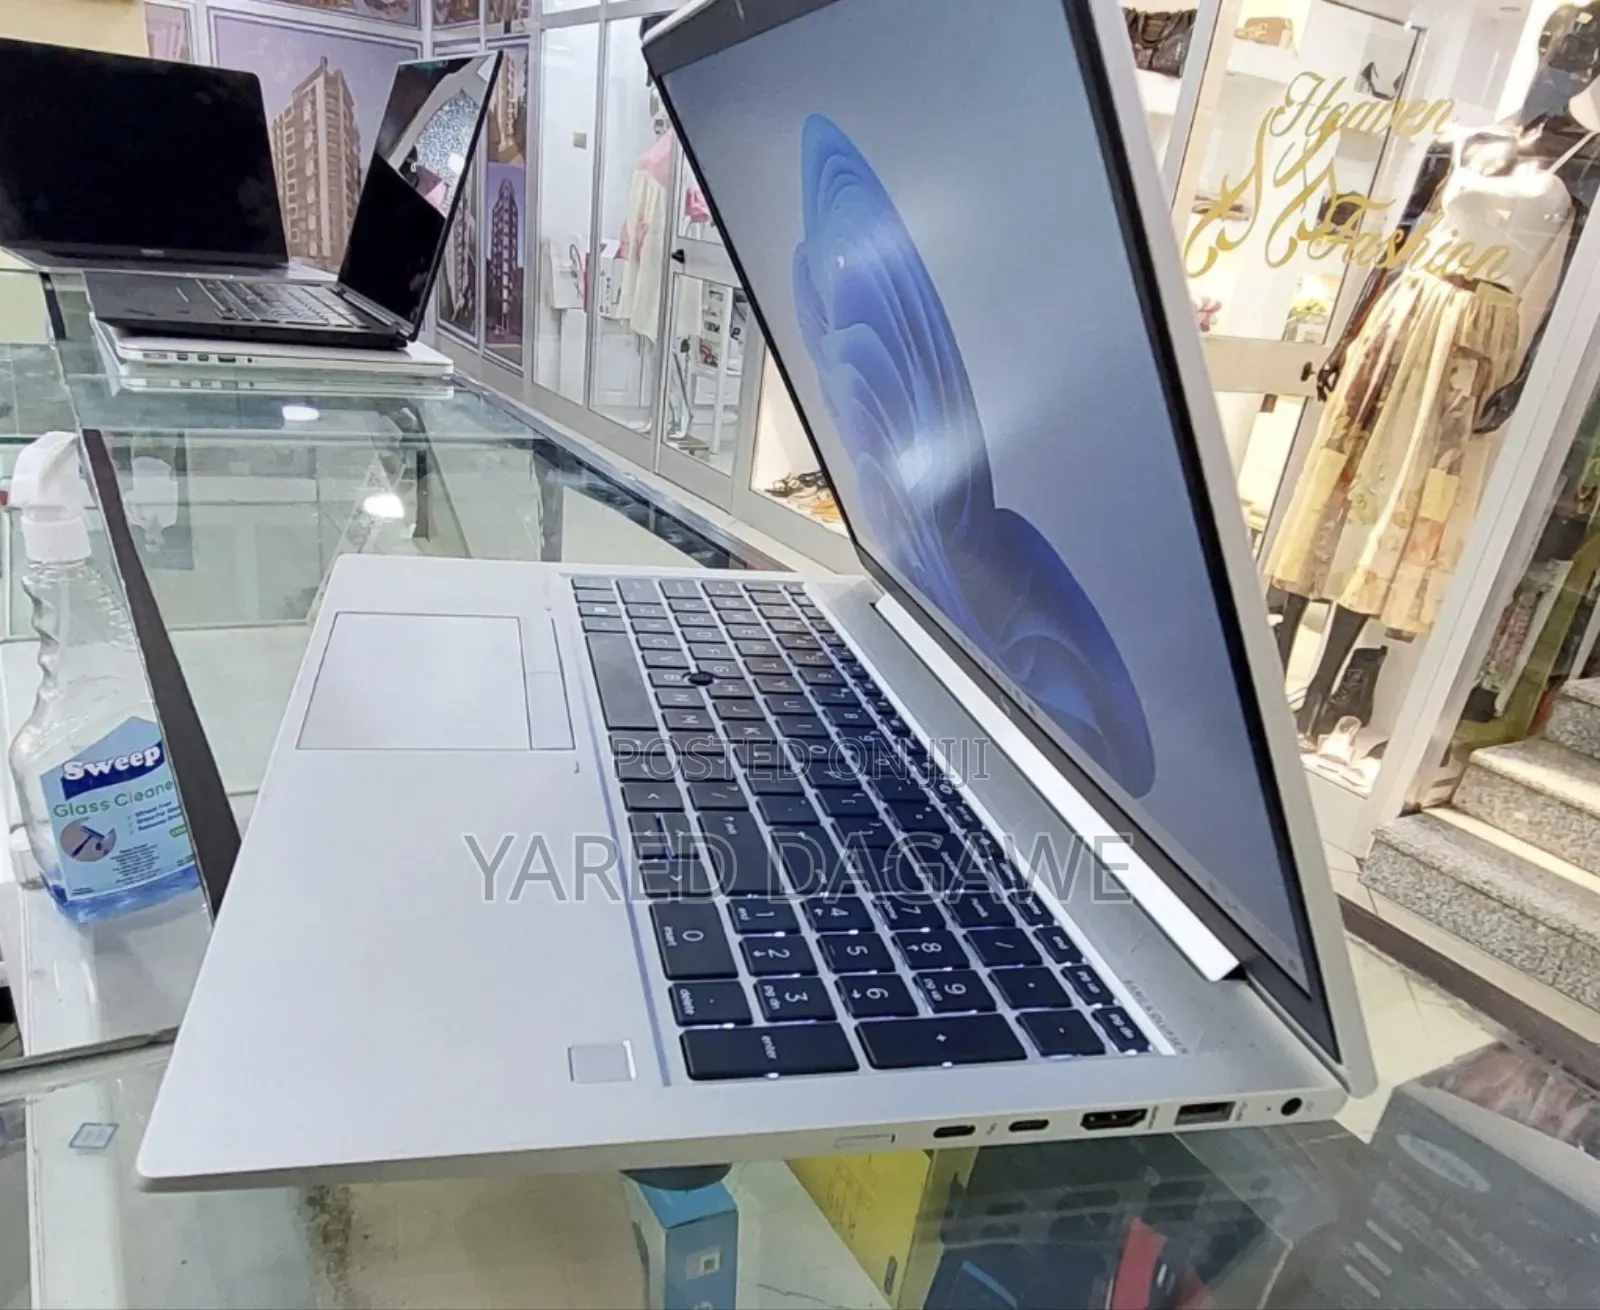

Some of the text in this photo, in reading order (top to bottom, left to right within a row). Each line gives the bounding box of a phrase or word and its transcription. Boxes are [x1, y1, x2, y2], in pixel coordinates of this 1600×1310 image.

[1270, 71, 1457, 138] Heaven
[1307, 195, 1513, 281] Fashion
[713, 665, 730, 673] G
[663, 673, 681, 681] B
[723, 684, 739, 692] H
[674, 694, 689, 702] N
[731, 705, 749, 713] J
[783, 700, 801, 708] U
[682, 714, 699, 724] M
[743, 726, 761, 735] K
[63, 745, 161, 781] Sweep
[53, 800, 111, 818] Glass
[114, 781, 173, 807] Cleane
[755, 910, 776, 918] 1
[830, 906, 850, 917] 4
[900, 905, 922, 915] 7
[846, 944, 869, 956] 5
[920, 941, 943, 953] 8
[767, 948, 790, 959] 2
[865, 986, 889, 1000] 6
[943, 982, 967, 996] 9
[678, 988, 696, 1016] delete
[784, 990, 809, 1003] 3
[761, 1034, 777, 1060] enter
